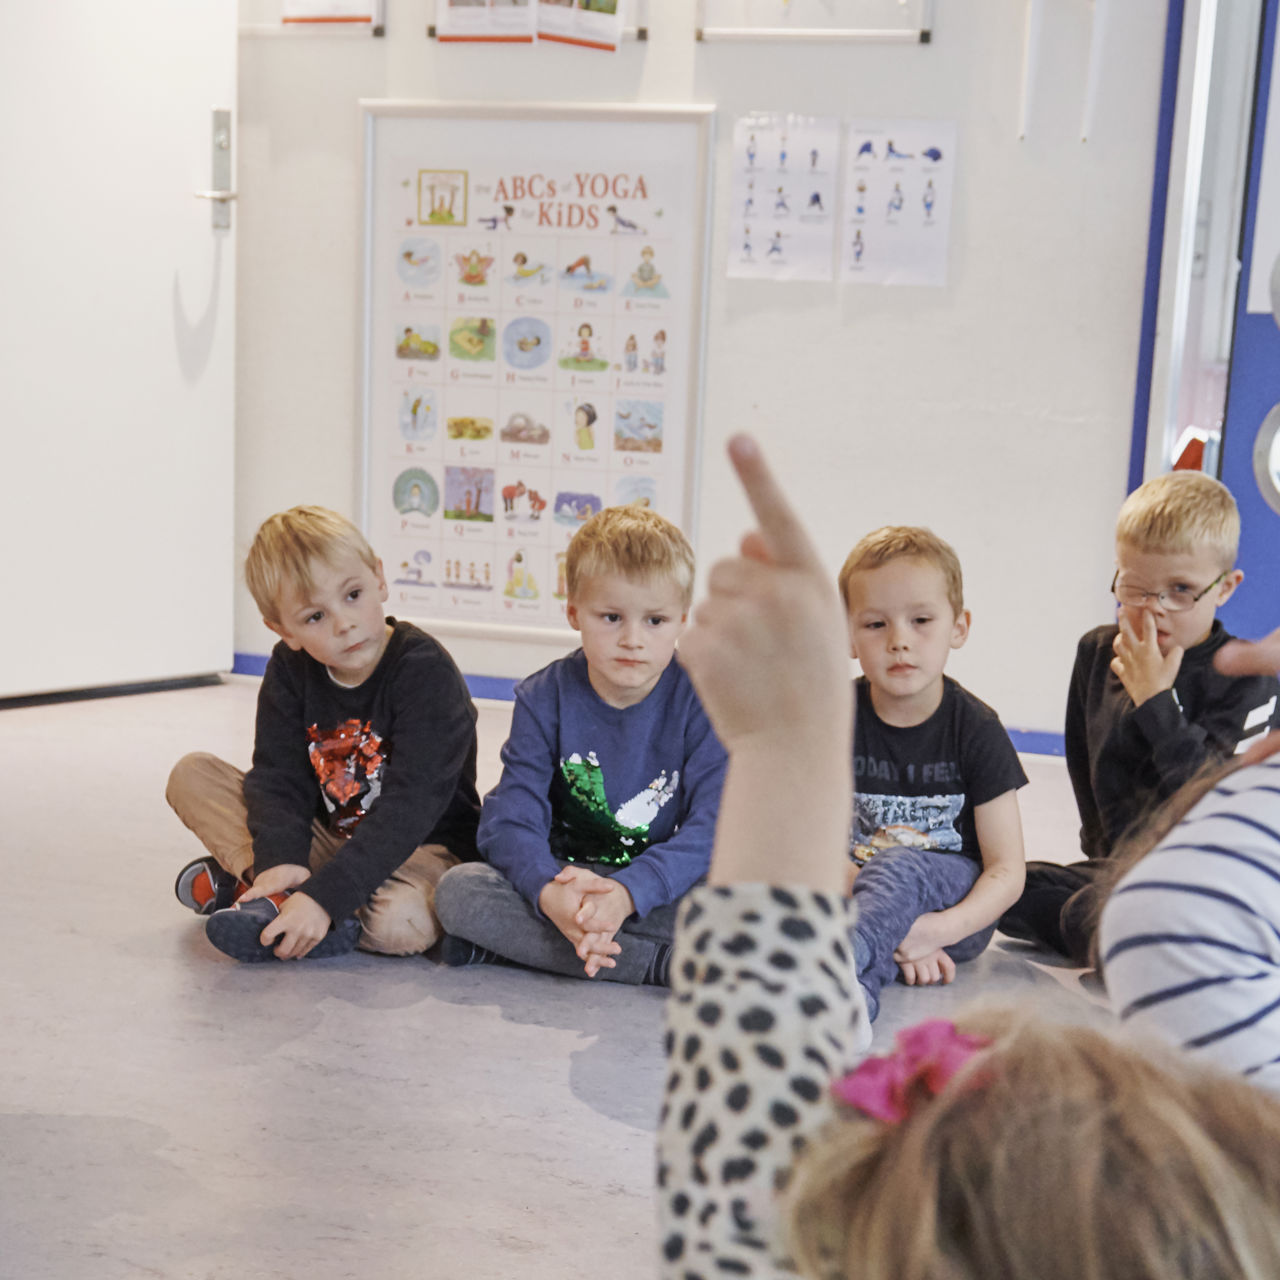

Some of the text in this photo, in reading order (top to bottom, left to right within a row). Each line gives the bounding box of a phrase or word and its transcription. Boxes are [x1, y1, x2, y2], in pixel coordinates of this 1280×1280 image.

[494, 173, 558, 202] ABCs
[574, 172, 648, 200] YOGA
[853, 755, 900, 782] ODAY
